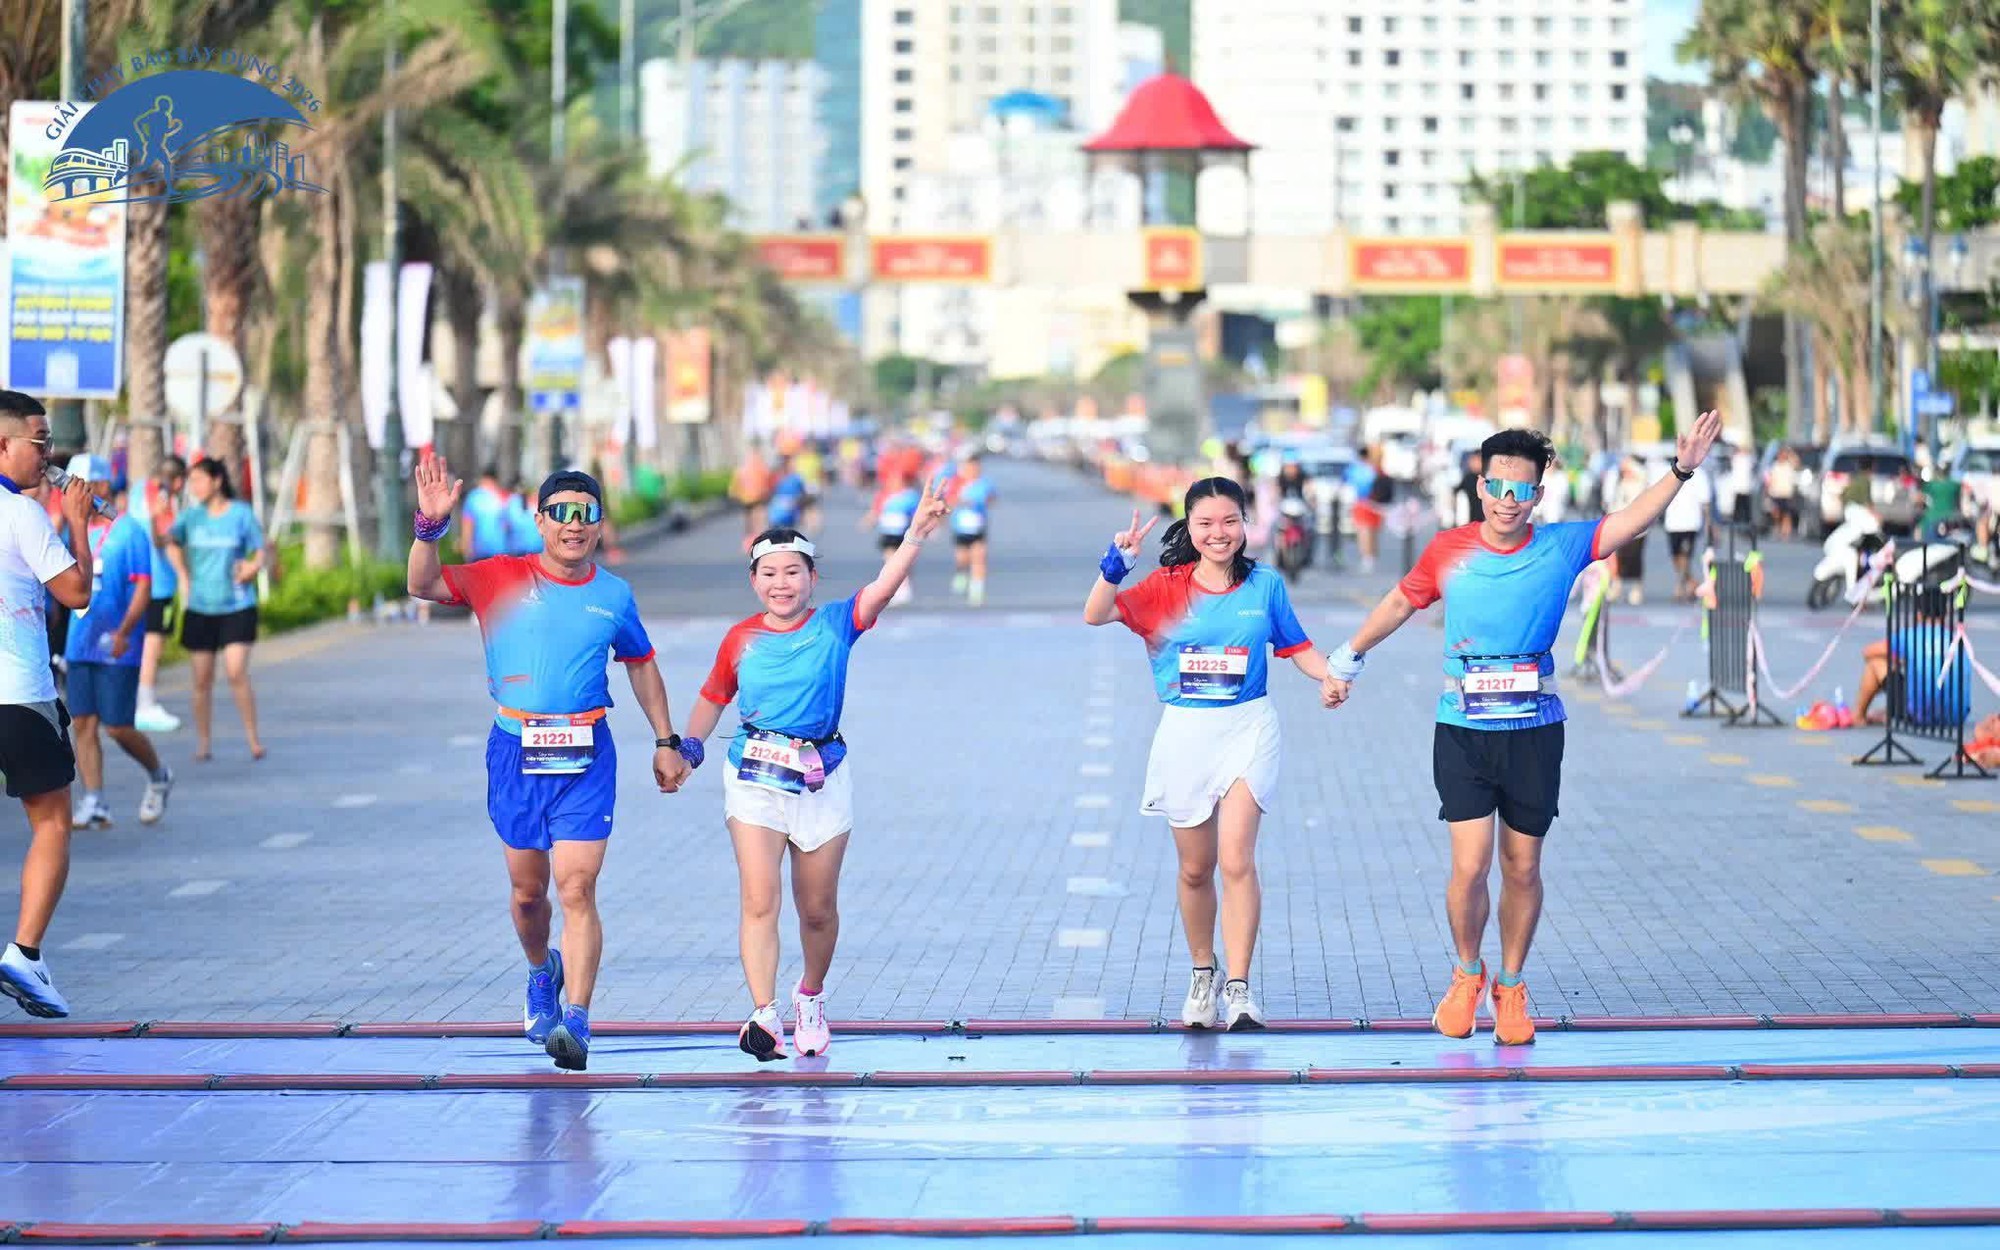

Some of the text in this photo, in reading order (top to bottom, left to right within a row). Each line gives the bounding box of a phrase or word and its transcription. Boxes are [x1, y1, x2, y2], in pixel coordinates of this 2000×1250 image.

[1187, 660, 1228, 671] 21225
[1476, 678, 1516, 690] 21217
[532, 732, 573, 745] 21221
[750, 746, 791, 765] 21244
